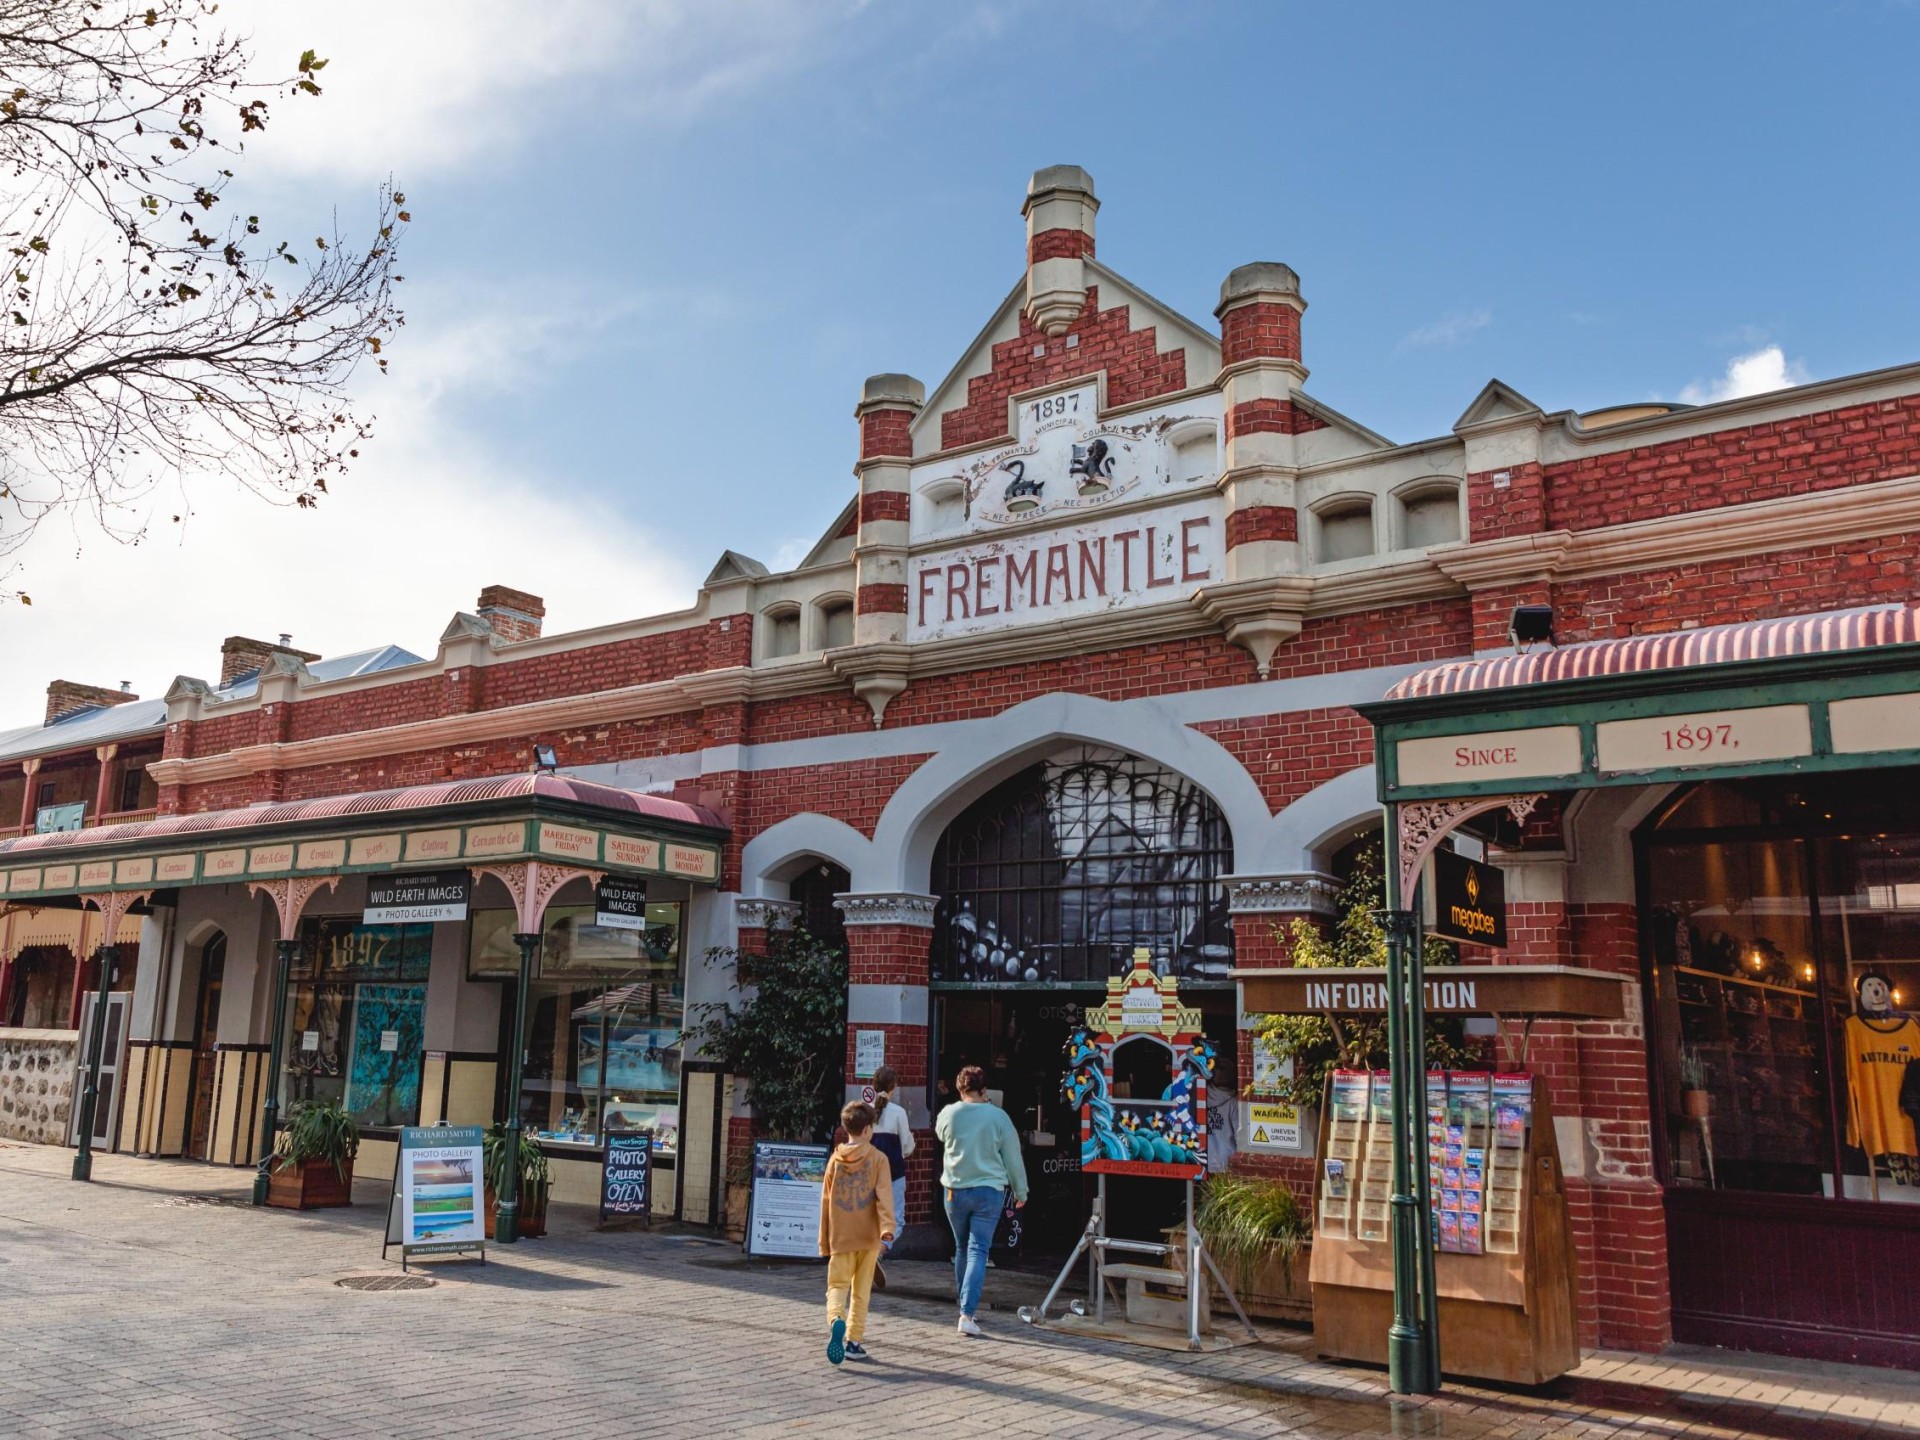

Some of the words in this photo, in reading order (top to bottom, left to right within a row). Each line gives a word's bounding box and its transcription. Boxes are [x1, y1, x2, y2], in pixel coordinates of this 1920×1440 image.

[1034, 394, 1079, 422] 1897
[992, 445, 1034, 463] FREMANTLE
[1035, 418, 1077, 436] MUNICIPAL
[993, 513, 1010, 522] NEC
[1016, 505, 1047, 521] PRECE
[1064, 499, 1081, 507] NEC
[1089, 485, 1126, 505] PRETIO
[918, 516, 1210, 627] FREMANTLE
[1662, 723, 1739, 751] 1897,
[543, 830, 574, 843] MARKET
[575, 834, 593, 845] OPEN
[555, 841, 581, 851] FRIDAY
[611, 841, 652, 854] SATURDAY
[616, 852, 646, 864] SUNDAY
[674, 851, 705, 863] HOLIDAY
[675, 860, 704, 873] MONDAY
[371, 890, 394, 904] WILD
[396, 889, 425, 902] EARTH
[428, 886, 463, 900] IMAGES
[601, 888, 620, 899] WILD
[622, 890, 645, 902] EARTH
[385, 910, 410, 919] PHOTO
[412, 908, 443, 918] GALLERY
[609, 901, 637, 912] IMAGES
[1451, 905, 1495, 935] megabes
[331, 932, 392, 967] 1897
[410, 1131, 447, 1139] RICHARD
[449, 1129, 475, 1138] SMYTH
[1270, 1135, 1297, 1143] GROUND
[1271, 1128, 1296, 1136] UNEVEN
[412, 1150, 439, 1159] PHOTO
[440, 1149, 473, 1158] GALLERY
[609, 1150, 646, 1165] PHOTO
[1043, 1159, 1080, 1173] COFFEE
[606, 1166, 646, 1181] GALLERY
[608, 1183, 645, 1201] OPEN
[411, 1244, 476, 1253] www.richardsmyth.com.au
